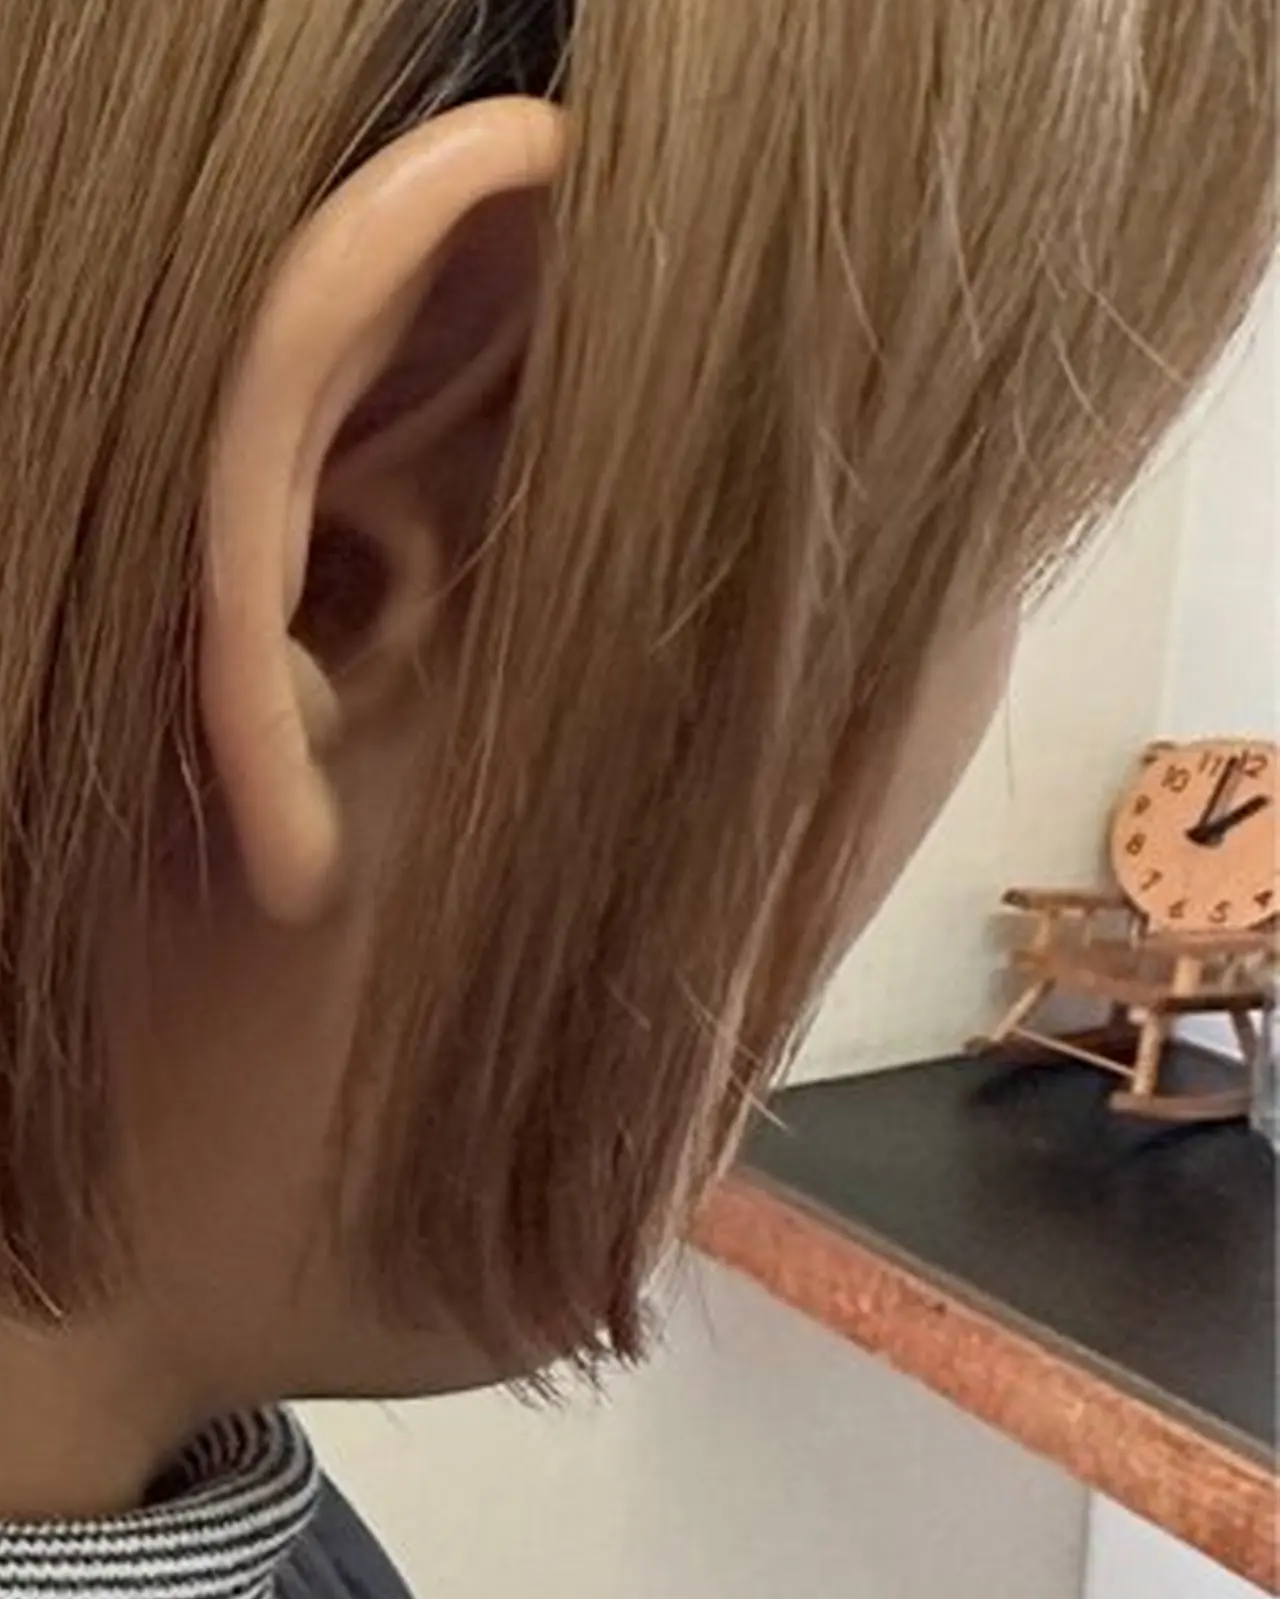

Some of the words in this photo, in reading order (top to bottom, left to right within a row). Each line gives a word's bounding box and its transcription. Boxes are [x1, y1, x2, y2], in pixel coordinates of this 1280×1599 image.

[1198, 751, 1224, 777] 11
[1240, 750, 1268, 778] 12
[1161, 764, 1190, 792] 10
[1133, 795, 1152, 815] 9
[1125, 832, 1147, 856] 8
[1141, 868, 1163, 891] 7
[1168, 899, 1187, 919] 6
[1209, 899, 1231, 923] 5
[1253, 889, 1274, 910] 4
